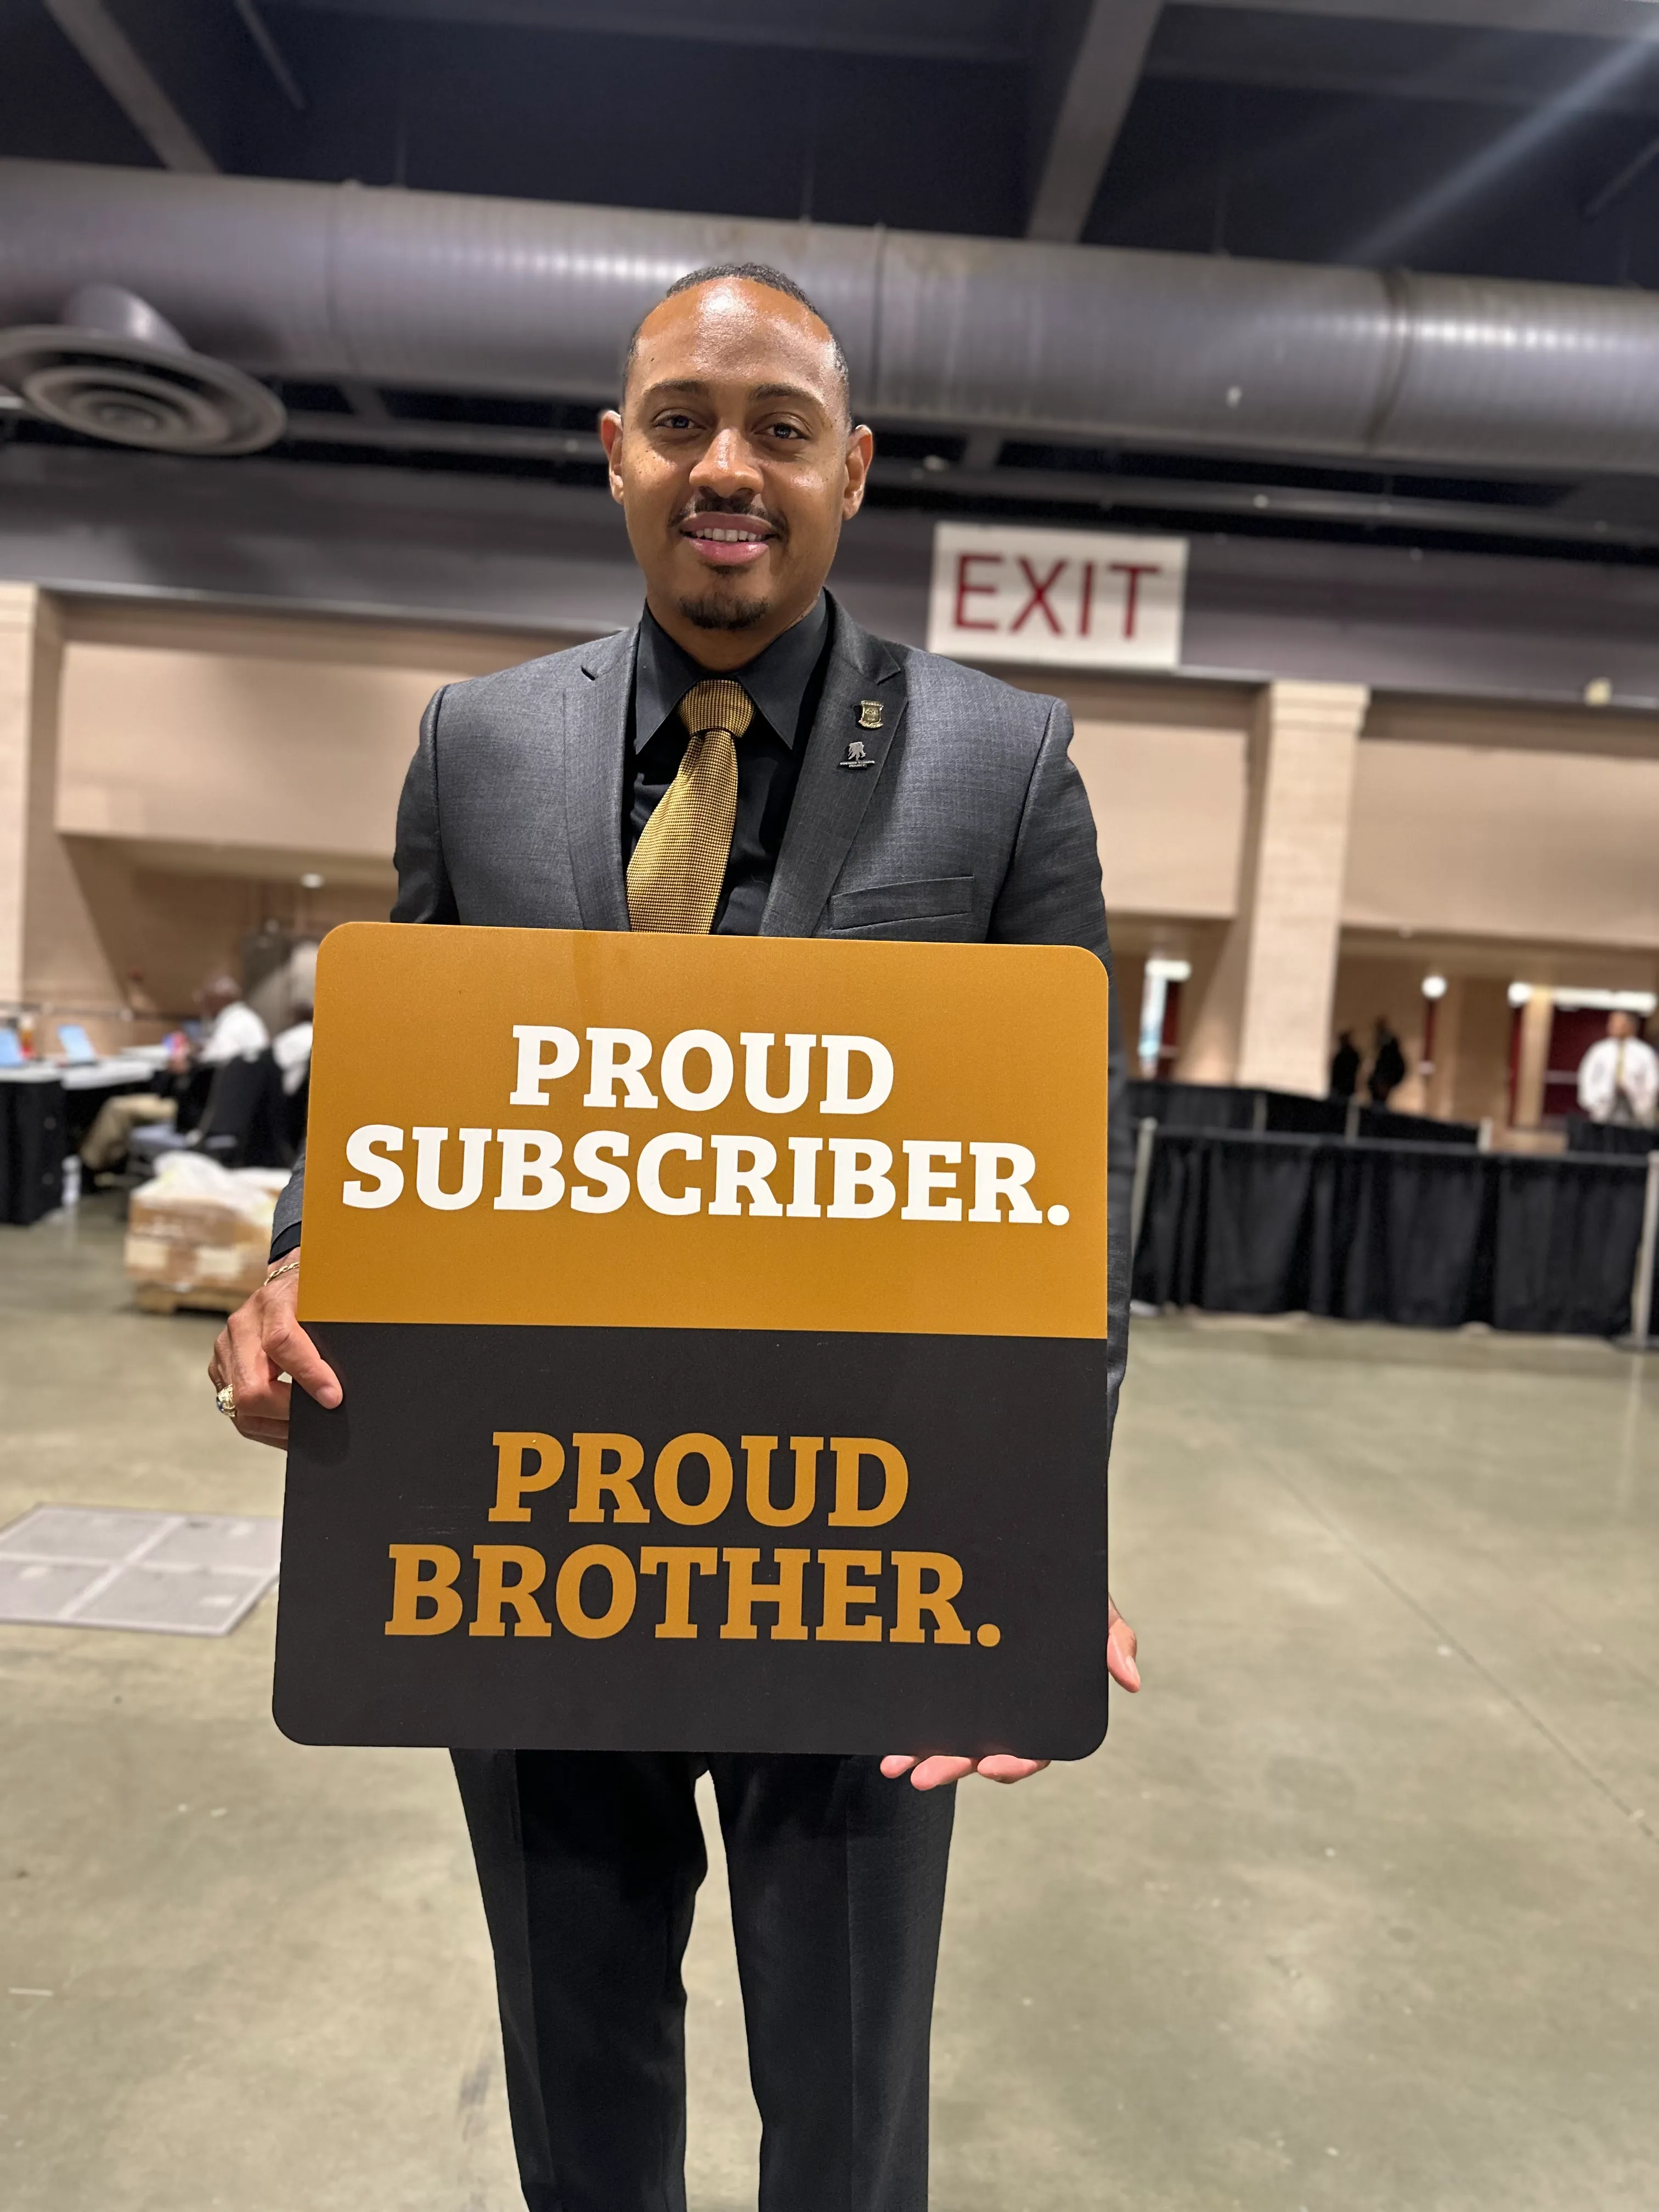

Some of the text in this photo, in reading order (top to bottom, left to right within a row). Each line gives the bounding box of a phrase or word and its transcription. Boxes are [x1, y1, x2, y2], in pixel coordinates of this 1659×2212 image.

[954, 552, 1162, 639] EXIT
[509, 1024, 894, 1115] PROUD
[342, 1124, 1070, 1226] SUBSCRIBER.
[488, 1431, 909, 1528] PROUD
[384, 1544, 1001, 1648] BROTHER.
